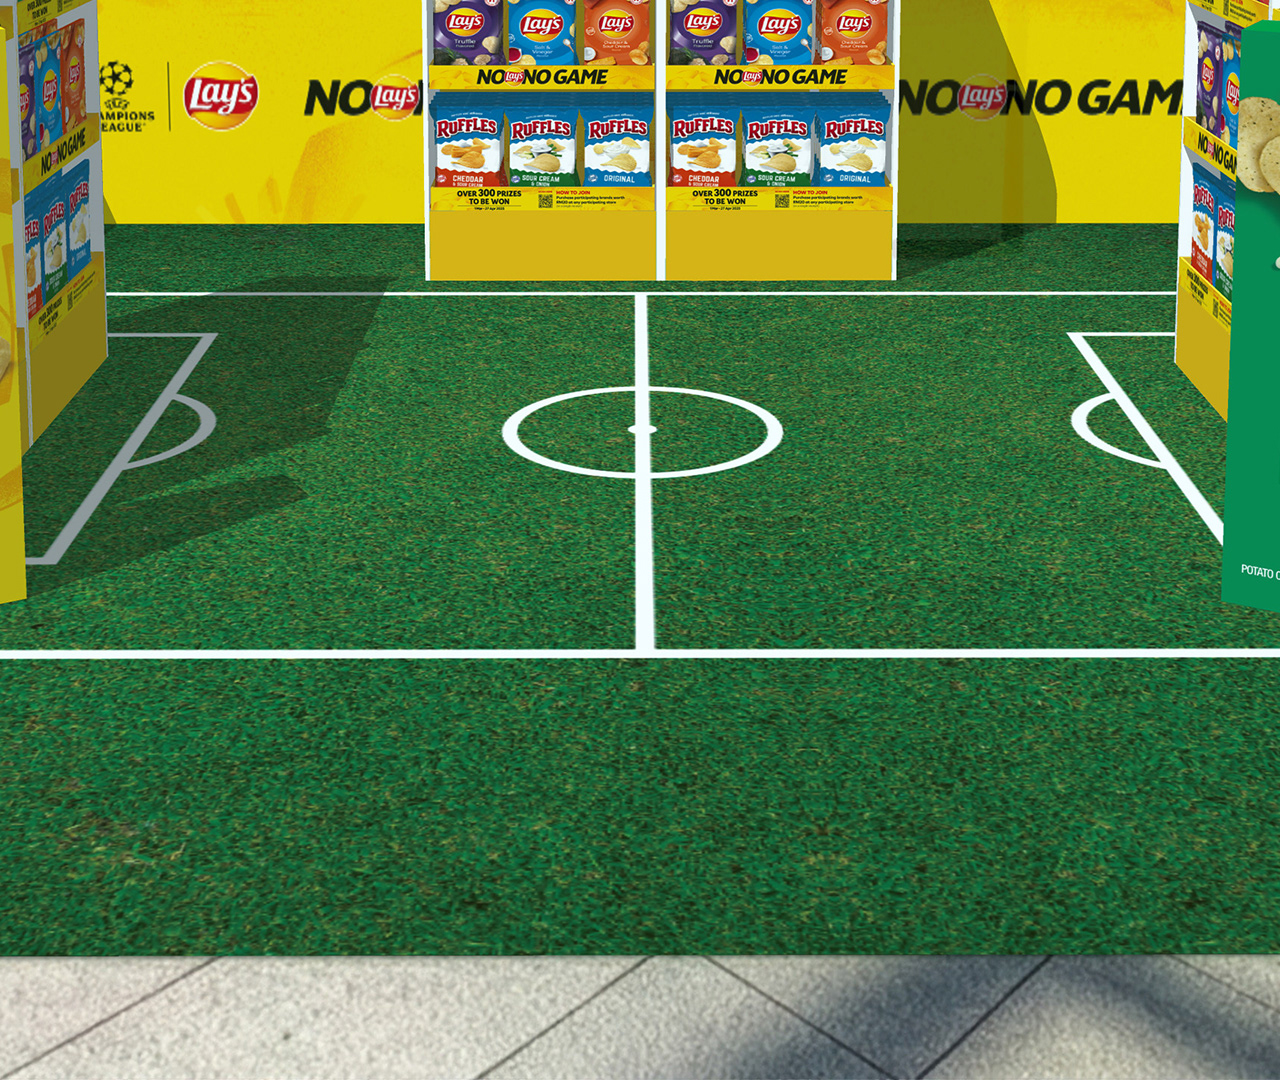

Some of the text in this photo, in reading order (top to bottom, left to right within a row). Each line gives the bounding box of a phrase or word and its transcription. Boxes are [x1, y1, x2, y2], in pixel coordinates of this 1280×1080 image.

[449, 14, 482, 31] Lay's
[523, 16, 561, 35] Lay's
[601, 16, 633, 33] Lay's
[687, 14, 720, 31] Lay's
[761, 16, 799, 35] Lay's
[839, 16, 870, 33] Lay's
[477, 69, 608, 84] NO Lay's NO GAME
[714, 69, 847, 84] NO Lay's NO GAME
[189, 78, 254, 115] Lay's
[304, 80, 416, 116] NO Lay's
[900, 80, 1183, 116] NO Lay's NO GAM
[100, 111, 155, 121] AMPIONS
[101, 123, 142, 132] EAGUE
[437, 118, 496, 137] RUFFLES
[512, 119, 570, 139] RUFFLES
[589, 119, 648, 139] RUFFLES
[674, 118, 733, 137] RUFFLES
[748, 119, 807, 139] RUFFLES
[825, 119, 884, 139] RUFFLES
[453, 175, 483, 183] CHEDDAR
[604, 175, 635, 183] ORIGINAL
[688, 175, 719, 183] CHEDDAR
[840, 175, 871, 183] ORIGINAL
[478, 189, 495, 198] 300
[1241, 564, 1275, 579] POTATO
